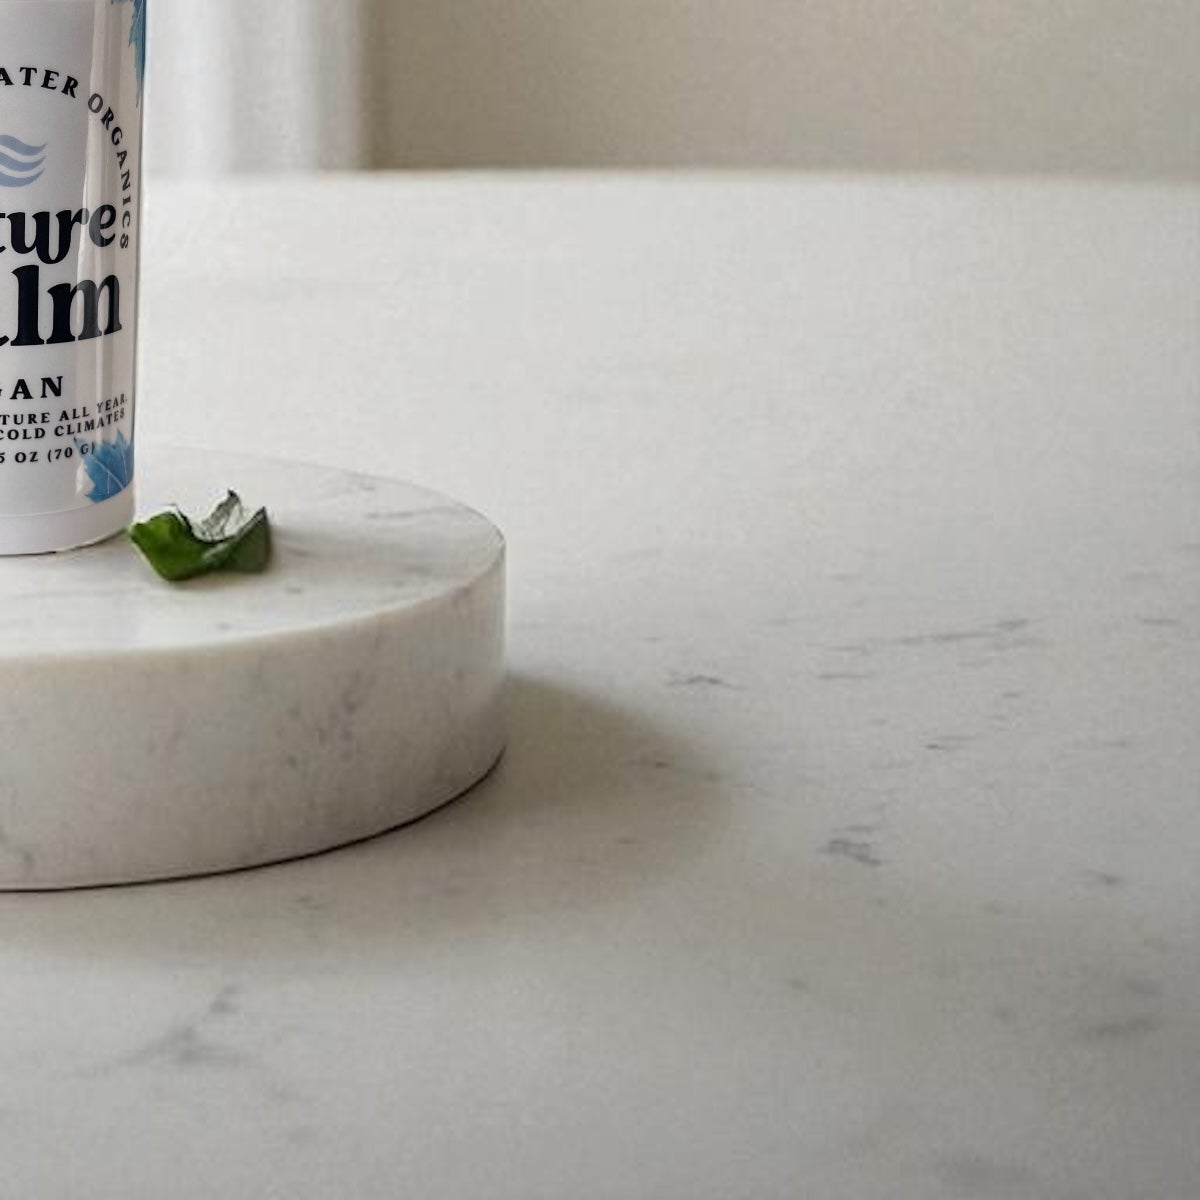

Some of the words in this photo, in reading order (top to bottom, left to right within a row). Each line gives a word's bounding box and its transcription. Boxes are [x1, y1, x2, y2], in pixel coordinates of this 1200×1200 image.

[88, 93, 131, 249] ORGANICS
[54, 408, 125, 437] CLIMATES
[59, 406, 90, 421] ALL
[15, 452, 38, 463] OZ
[47, 446, 73, 462] (70
